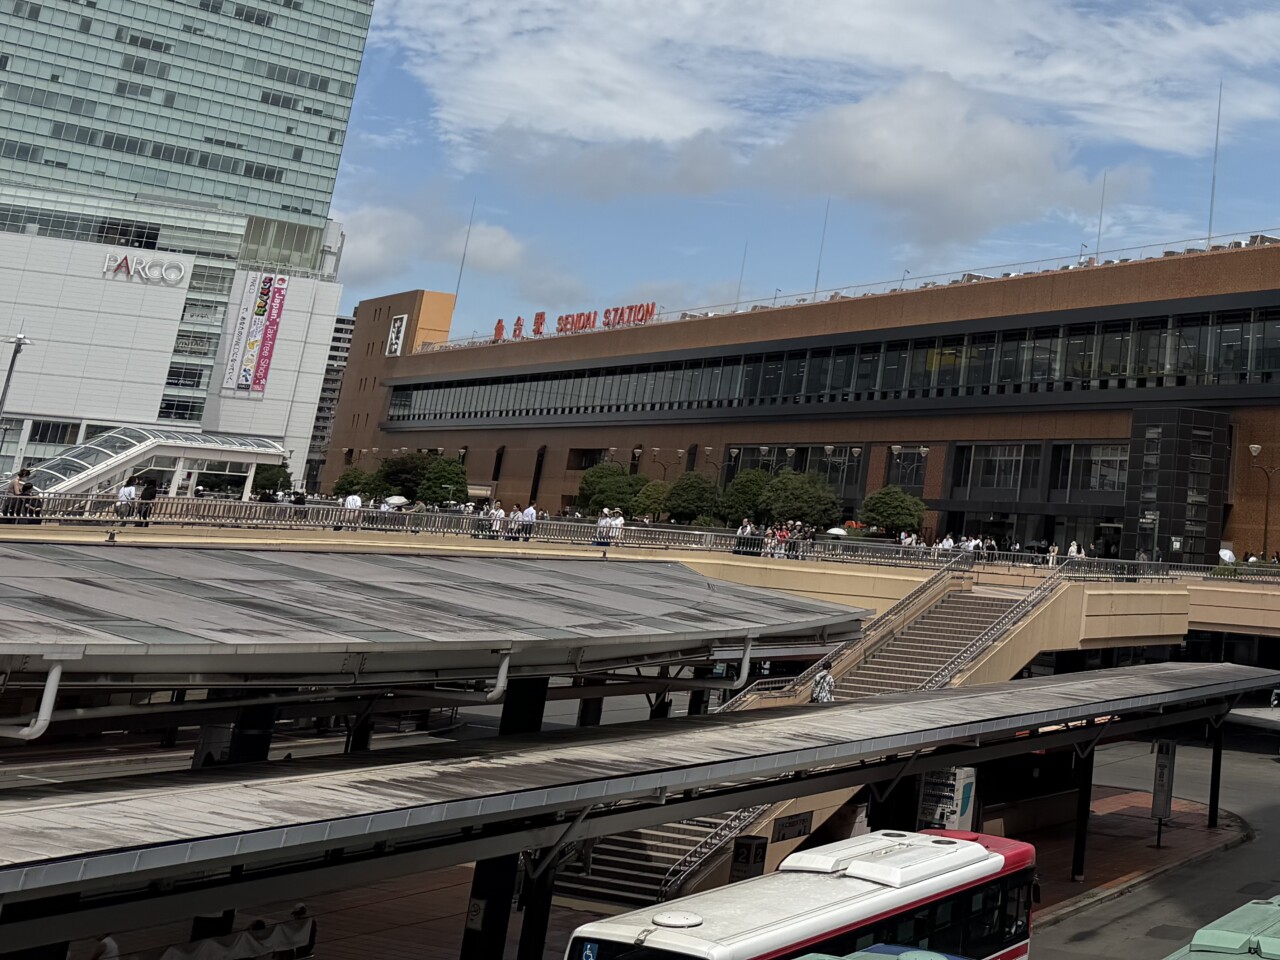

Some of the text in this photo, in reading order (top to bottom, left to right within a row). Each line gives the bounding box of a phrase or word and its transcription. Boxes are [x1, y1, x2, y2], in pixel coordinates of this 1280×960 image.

[103, 253, 185, 281] PARCO
[270, 293, 284, 321] Japan.
[556, 302, 656, 333] SENDAI STATION
[494, 312, 545, 340] 仙台駅
[262, 325, 277, 356] Tax-free
[257, 357, 269, 379] Shop
[738, 847, 747, 863] 2
[756, 849, 763, 863] 2
